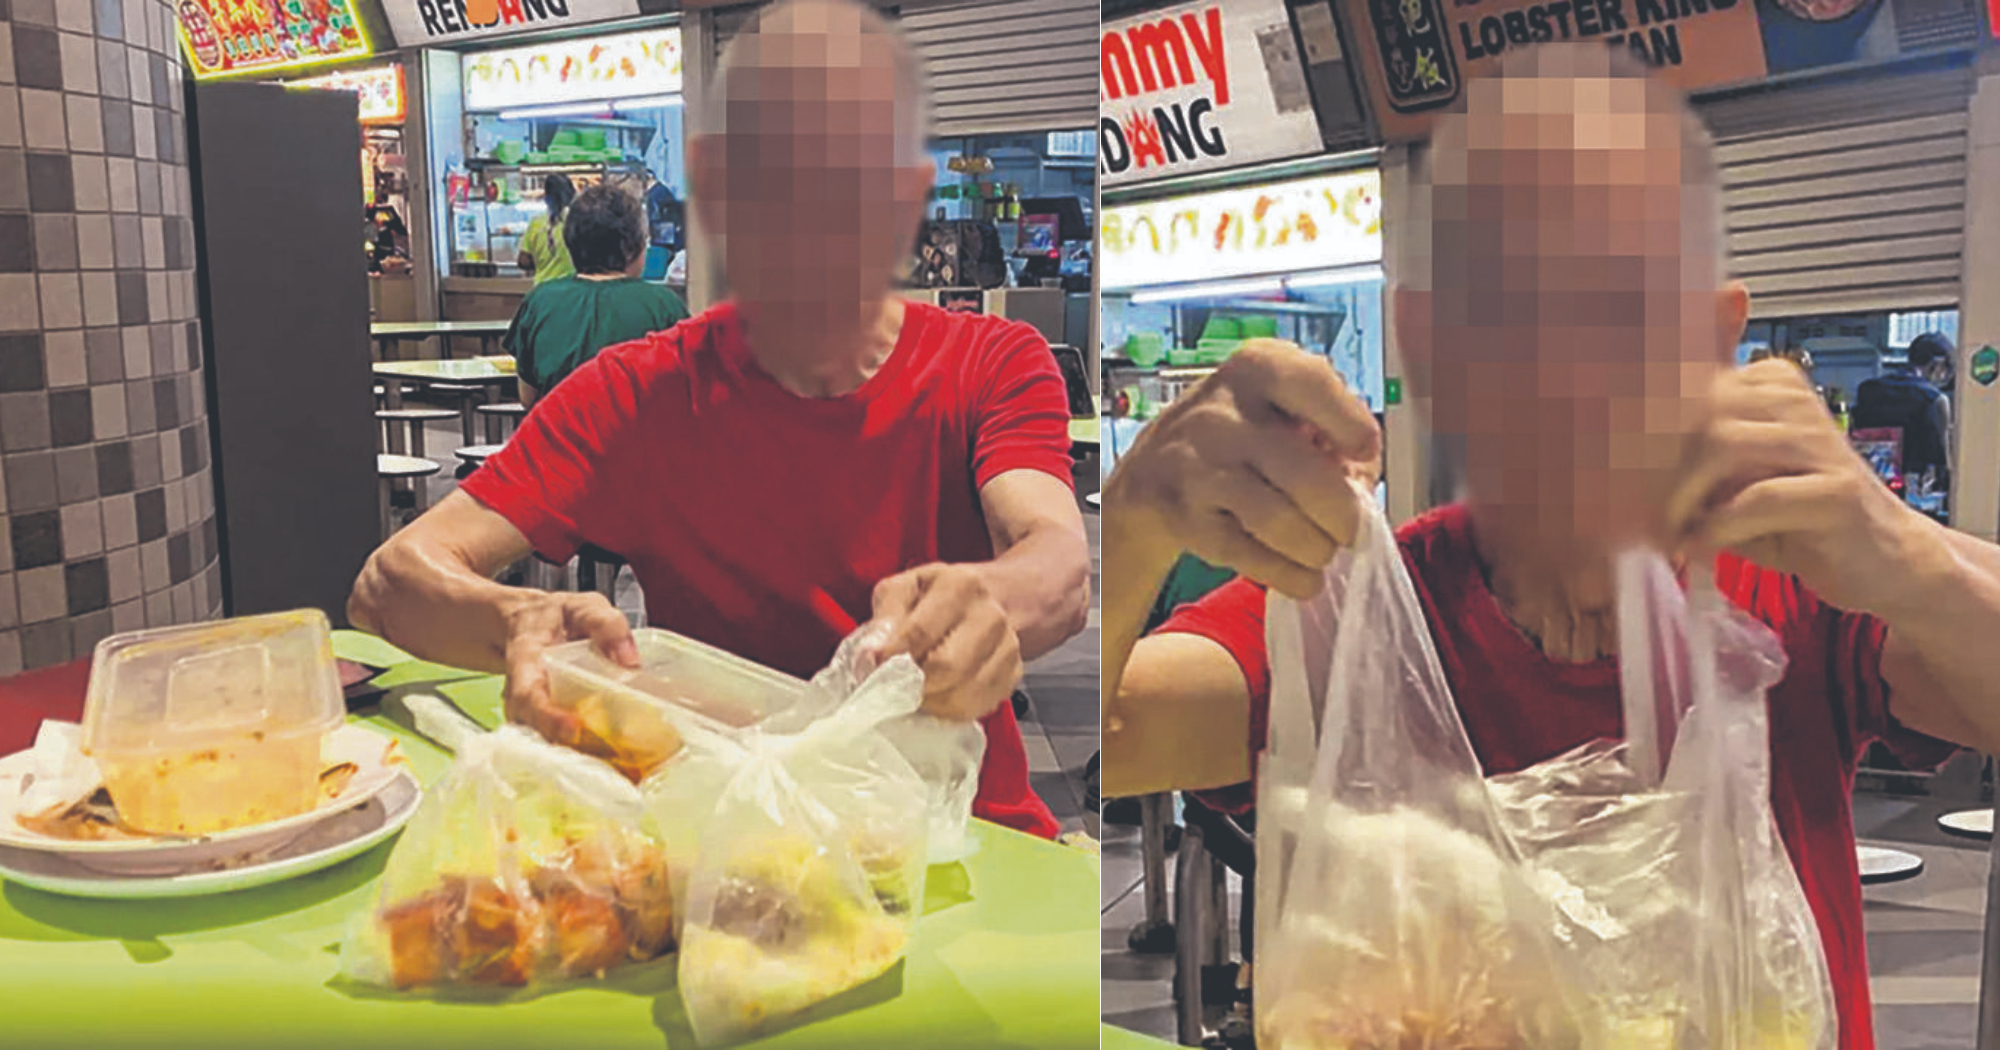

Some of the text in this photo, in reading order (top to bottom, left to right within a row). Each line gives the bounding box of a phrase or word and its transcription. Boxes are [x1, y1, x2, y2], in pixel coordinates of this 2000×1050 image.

[1458, 0, 1628, 61] LOBSTER
[1636, 0, 1739, 25] KIN
[1606, 24, 1682, 66] AN
[1100, 97, 1227, 175] DANG
